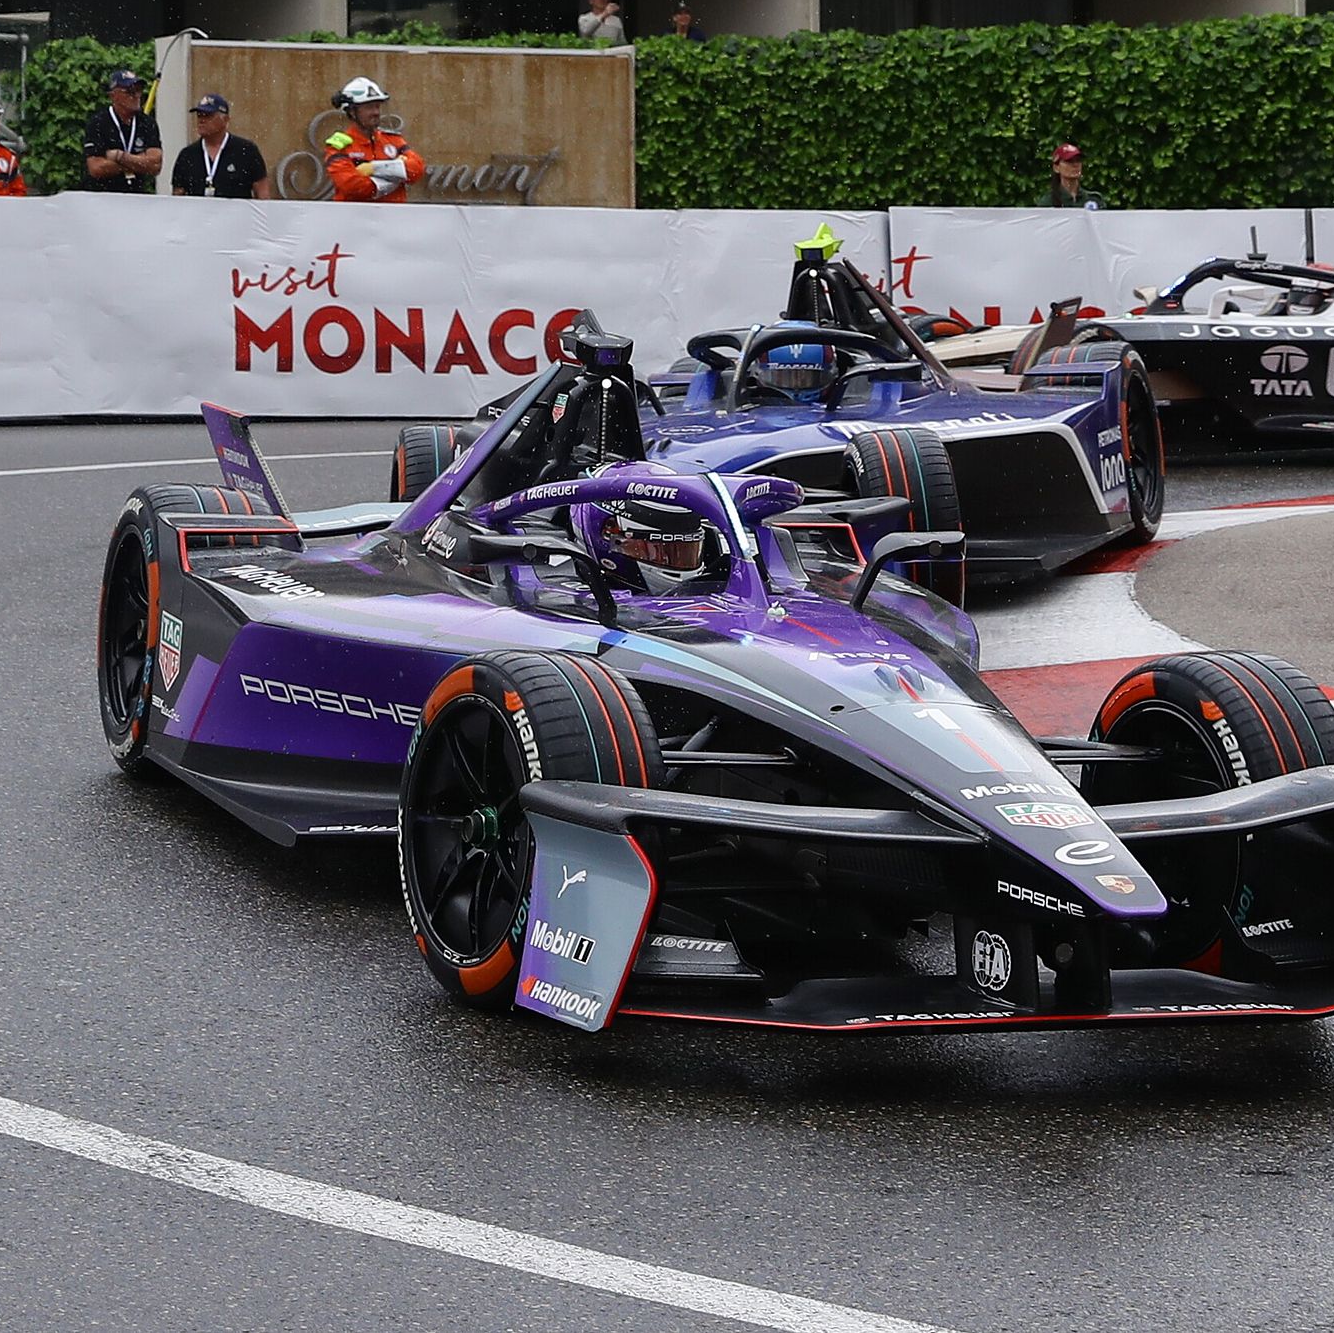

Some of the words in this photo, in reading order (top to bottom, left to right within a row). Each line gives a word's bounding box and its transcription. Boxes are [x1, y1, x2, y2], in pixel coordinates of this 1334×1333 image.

[231, 242, 355, 298] visit
[1250, 378, 1314, 396] TATA
[626, 482, 679, 500] LOCTITE
[161, 615, 180, 648] TAG
[808, 651, 911, 662] Ansys
[240, 674, 422, 727] PORSCHE
[913, 708, 962, 730] 1
[959, 782, 1047, 800] Mobil
[1004, 803, 1078, 816] TAG
[1010, 814, 1090, 827] HEUER
[997, 879, 1086, 917] PORSCHE
[1242, 919, 1294, 937] LOCTITE
[530, 920, 577, 959] Mobil
[651, 936, 727, 953] LOCTITE
